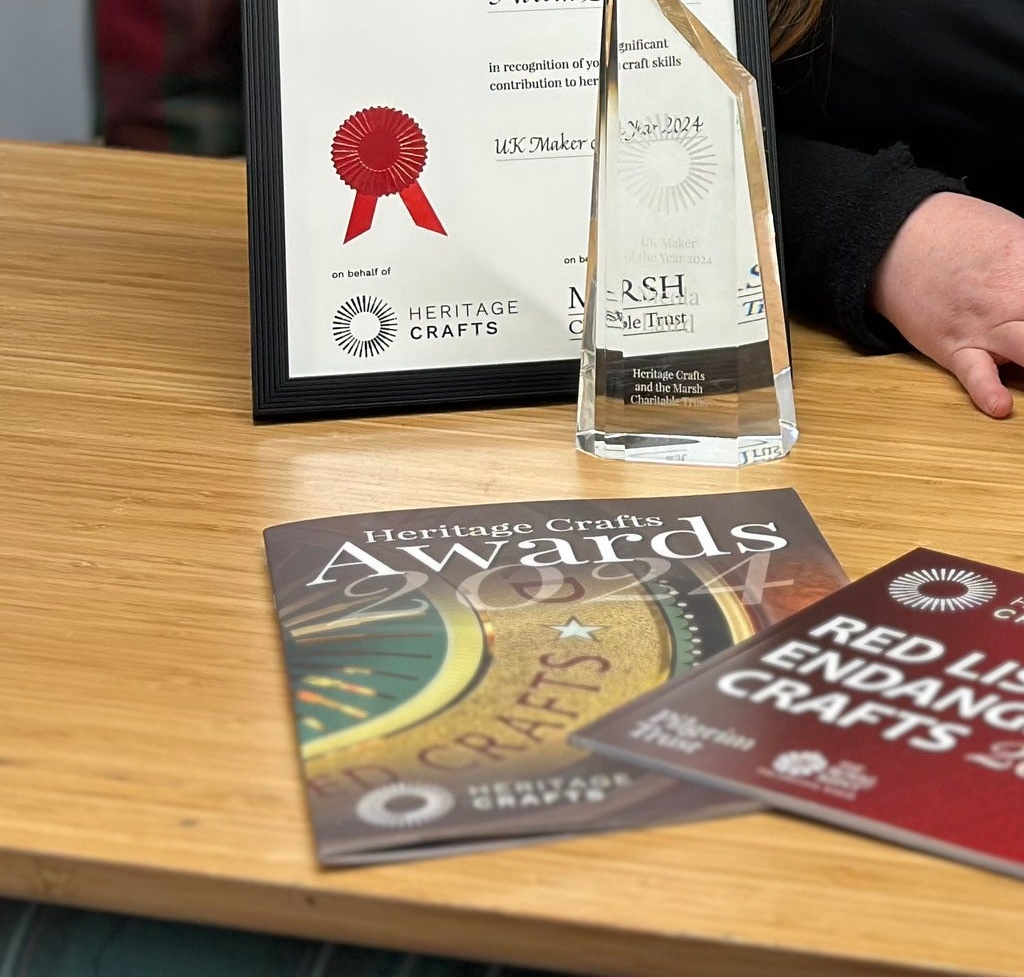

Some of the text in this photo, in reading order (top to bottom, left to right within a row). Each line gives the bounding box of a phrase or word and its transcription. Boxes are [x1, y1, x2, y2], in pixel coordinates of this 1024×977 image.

[489, 62, 500, 72] in
[503, 59, 569, 73] recognition
[572, 58, 585, 70] of
[619, 38, 669, 53] gnificant
[489, 78, 562, 92] contribution
[565, 78, 576, 88] to
[622, 58, 649, 70] craft
[652, 56, 681, 68] skills
[494, 136, 526, 154] UK
[529, 132, 588, 153] Maker
[663, 116, 704, 134] 2024
[332, 266, 391, 278] on behalf of
[687, 255, 712, 265] 2024
[409, 300, 519, 320] HERITAGE
[646, 313, 687, 327] Trust
[410, 321, 498, 340] CRAFTS
[632, 368, 706, 381] Heritage Crafts
[634, 382, 703, 394] and the Marsh
[363, 514, 664, 543] Heritage Crafts
[306, 515, 788, 586] Awards
[327, 551, 794, 626] 2024
[808, 615, 945, 663] RED
[418, 653, 612, 772] CRAFTS
[717, 670, 973, 751] CRAFTS
[468, 772, 632, 796] HERITAGE
[472, 789, 605, 810] CRAFTS
